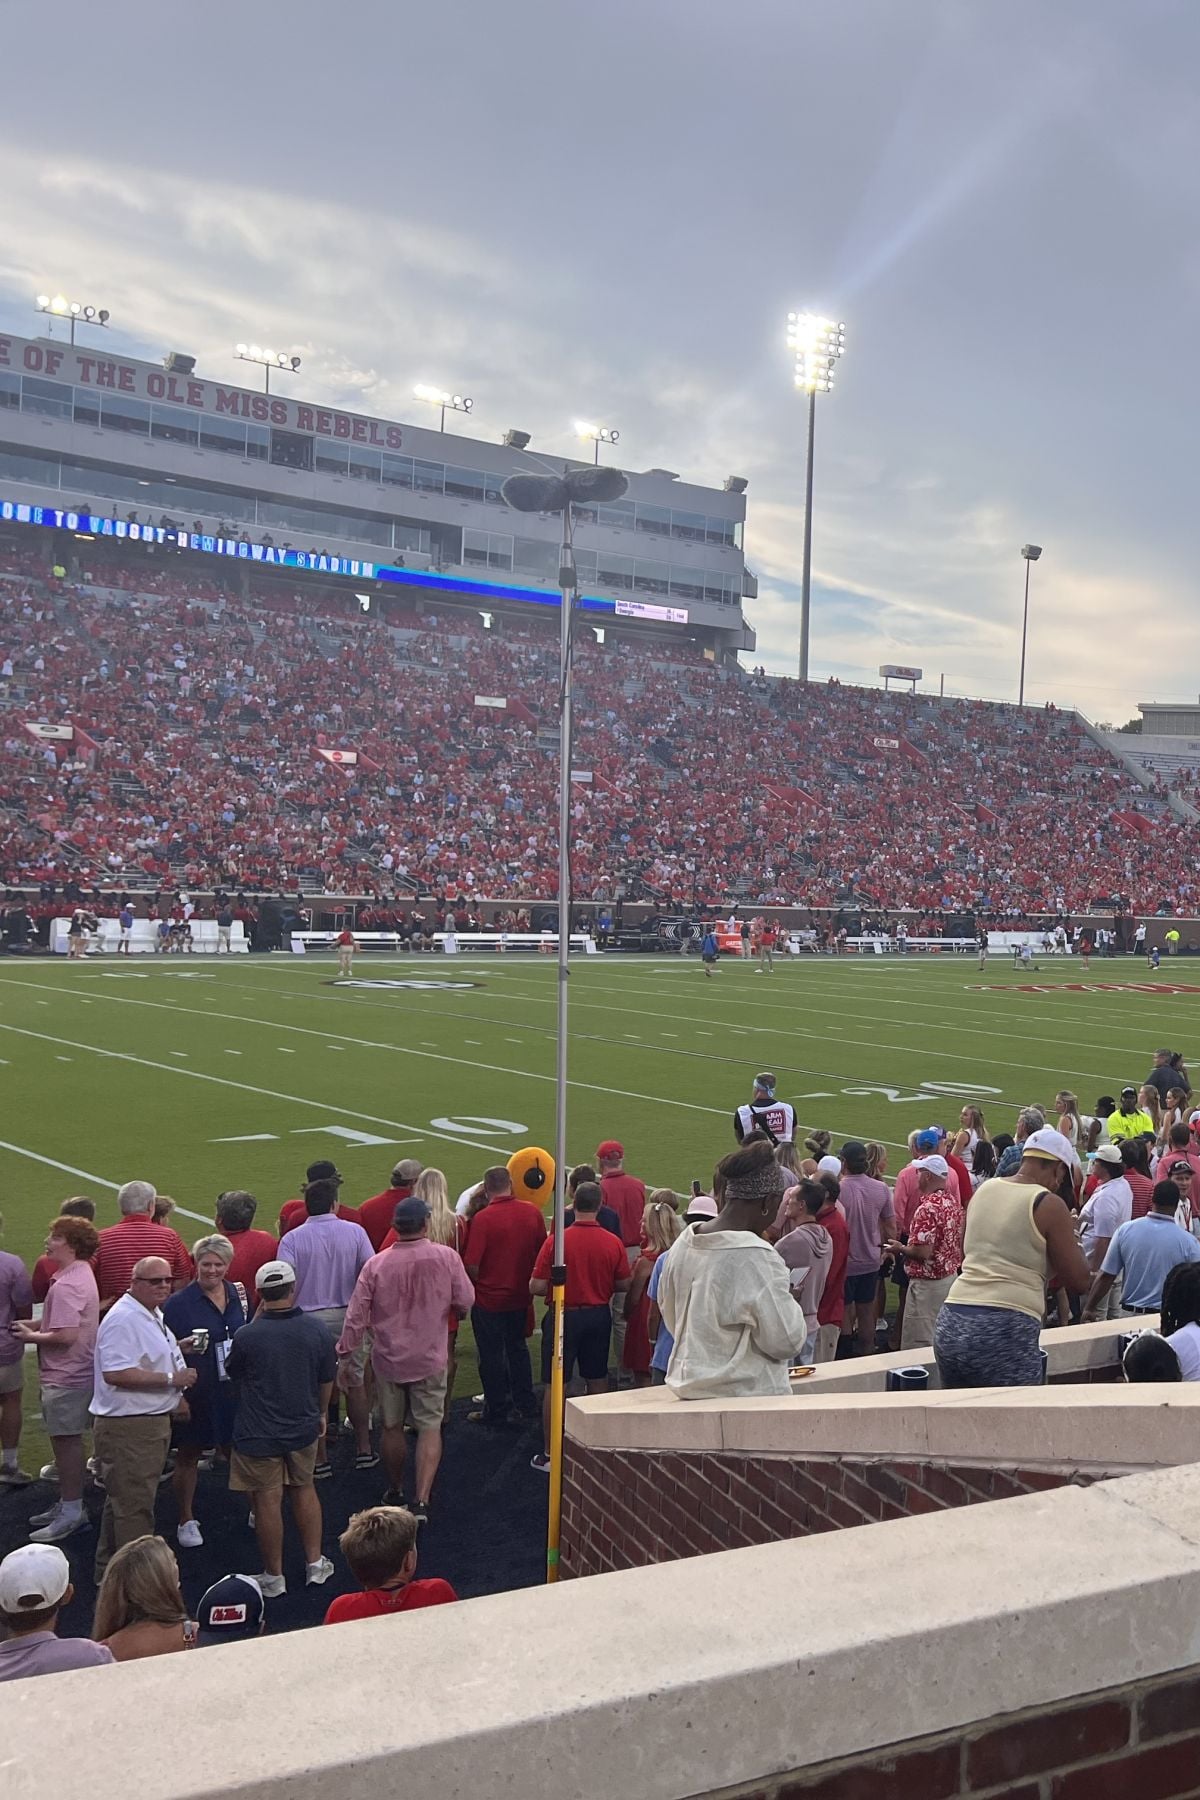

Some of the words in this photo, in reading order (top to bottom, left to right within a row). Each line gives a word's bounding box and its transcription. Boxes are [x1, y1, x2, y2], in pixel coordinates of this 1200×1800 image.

[24, 345, 64, 376] OF
[76, 356, 137, 392] THE
[147, 373, 204, 407] OLE
[216, 388, 287, 424] MISS
[297, 406, 402, 449] REBELS
[54, 510, 78, 530] TO
[296, 551, 373, 577] STADIUM
